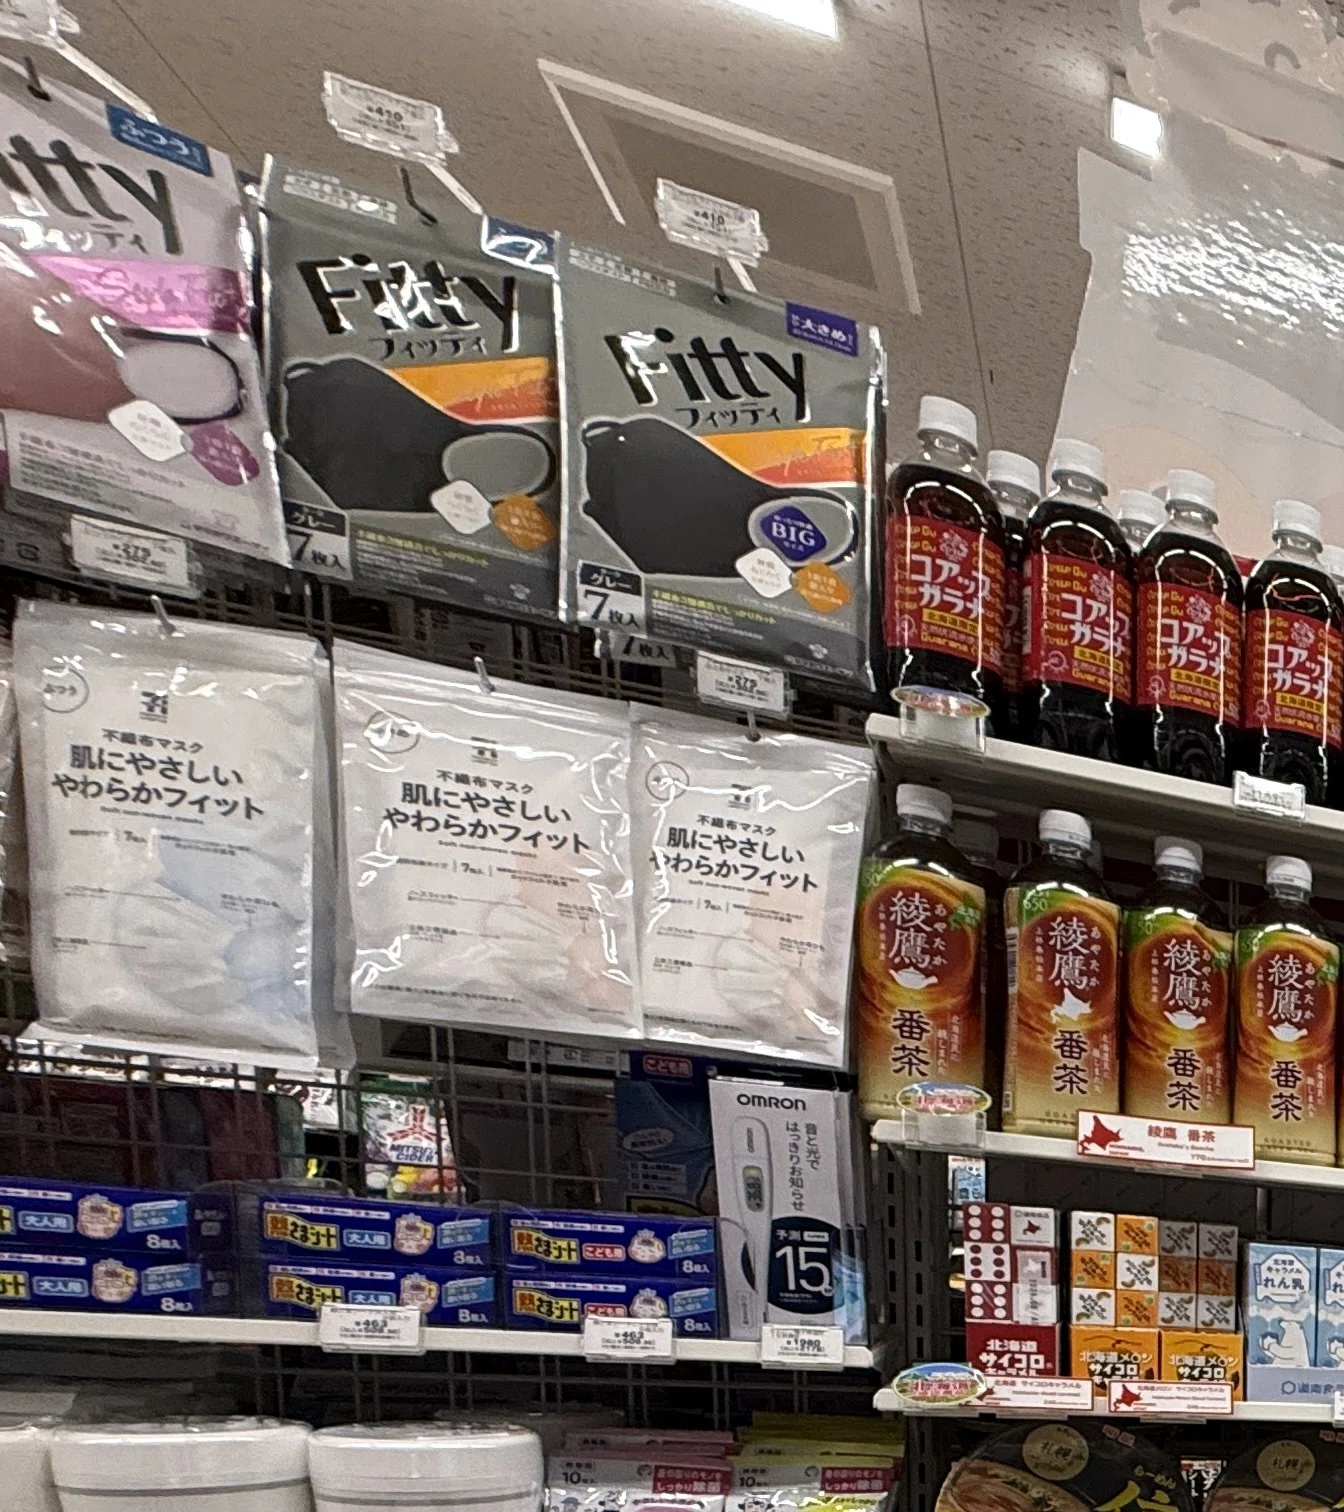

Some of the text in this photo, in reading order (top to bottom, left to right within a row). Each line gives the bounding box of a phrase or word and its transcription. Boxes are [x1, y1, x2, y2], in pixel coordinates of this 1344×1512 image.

[297, 253, 520, 353] Fitty
[604, 327, 811, 423] Fitty
[676, 403, 781, 429] フィッティ
[771, 521, 816, 547] BIG
[1160, 618, 1232, 657] コアップ
[1167, 644, 1225, 676] ガラナ
[102, 728, 203, 754] 不織布マスク
[69, 745, 243, 786] 肌にやさしい
[436, 769, 534, 796] 不織布マスク
[51, 773, 264, 820] やわらかフィット
[400, 782, 571, 825] 肌にやさしい
[382, 805, 589, 855] やわらかフィット
[667, 826, 805, 863] 肌にやさしい
[648, 851, 818, 893] やわらかフィット
[889, 891, 932, 968] 綾鷹
[1048, 916, 1089, 990] 綾鷹
[890, 1008, 931, 1078] 番茶
[1053, 1029, 1090, 1096] 番茶
[1166, 1048, 1202, 1113] 番茶
[1269, 1060, 1304, 1123] 番茶
[1263, 1276, 1305, 1292] れん乳
[979, 1352, 1046, 1369] サイコロ
[986, 1339, 1037, 1353] 北海道
